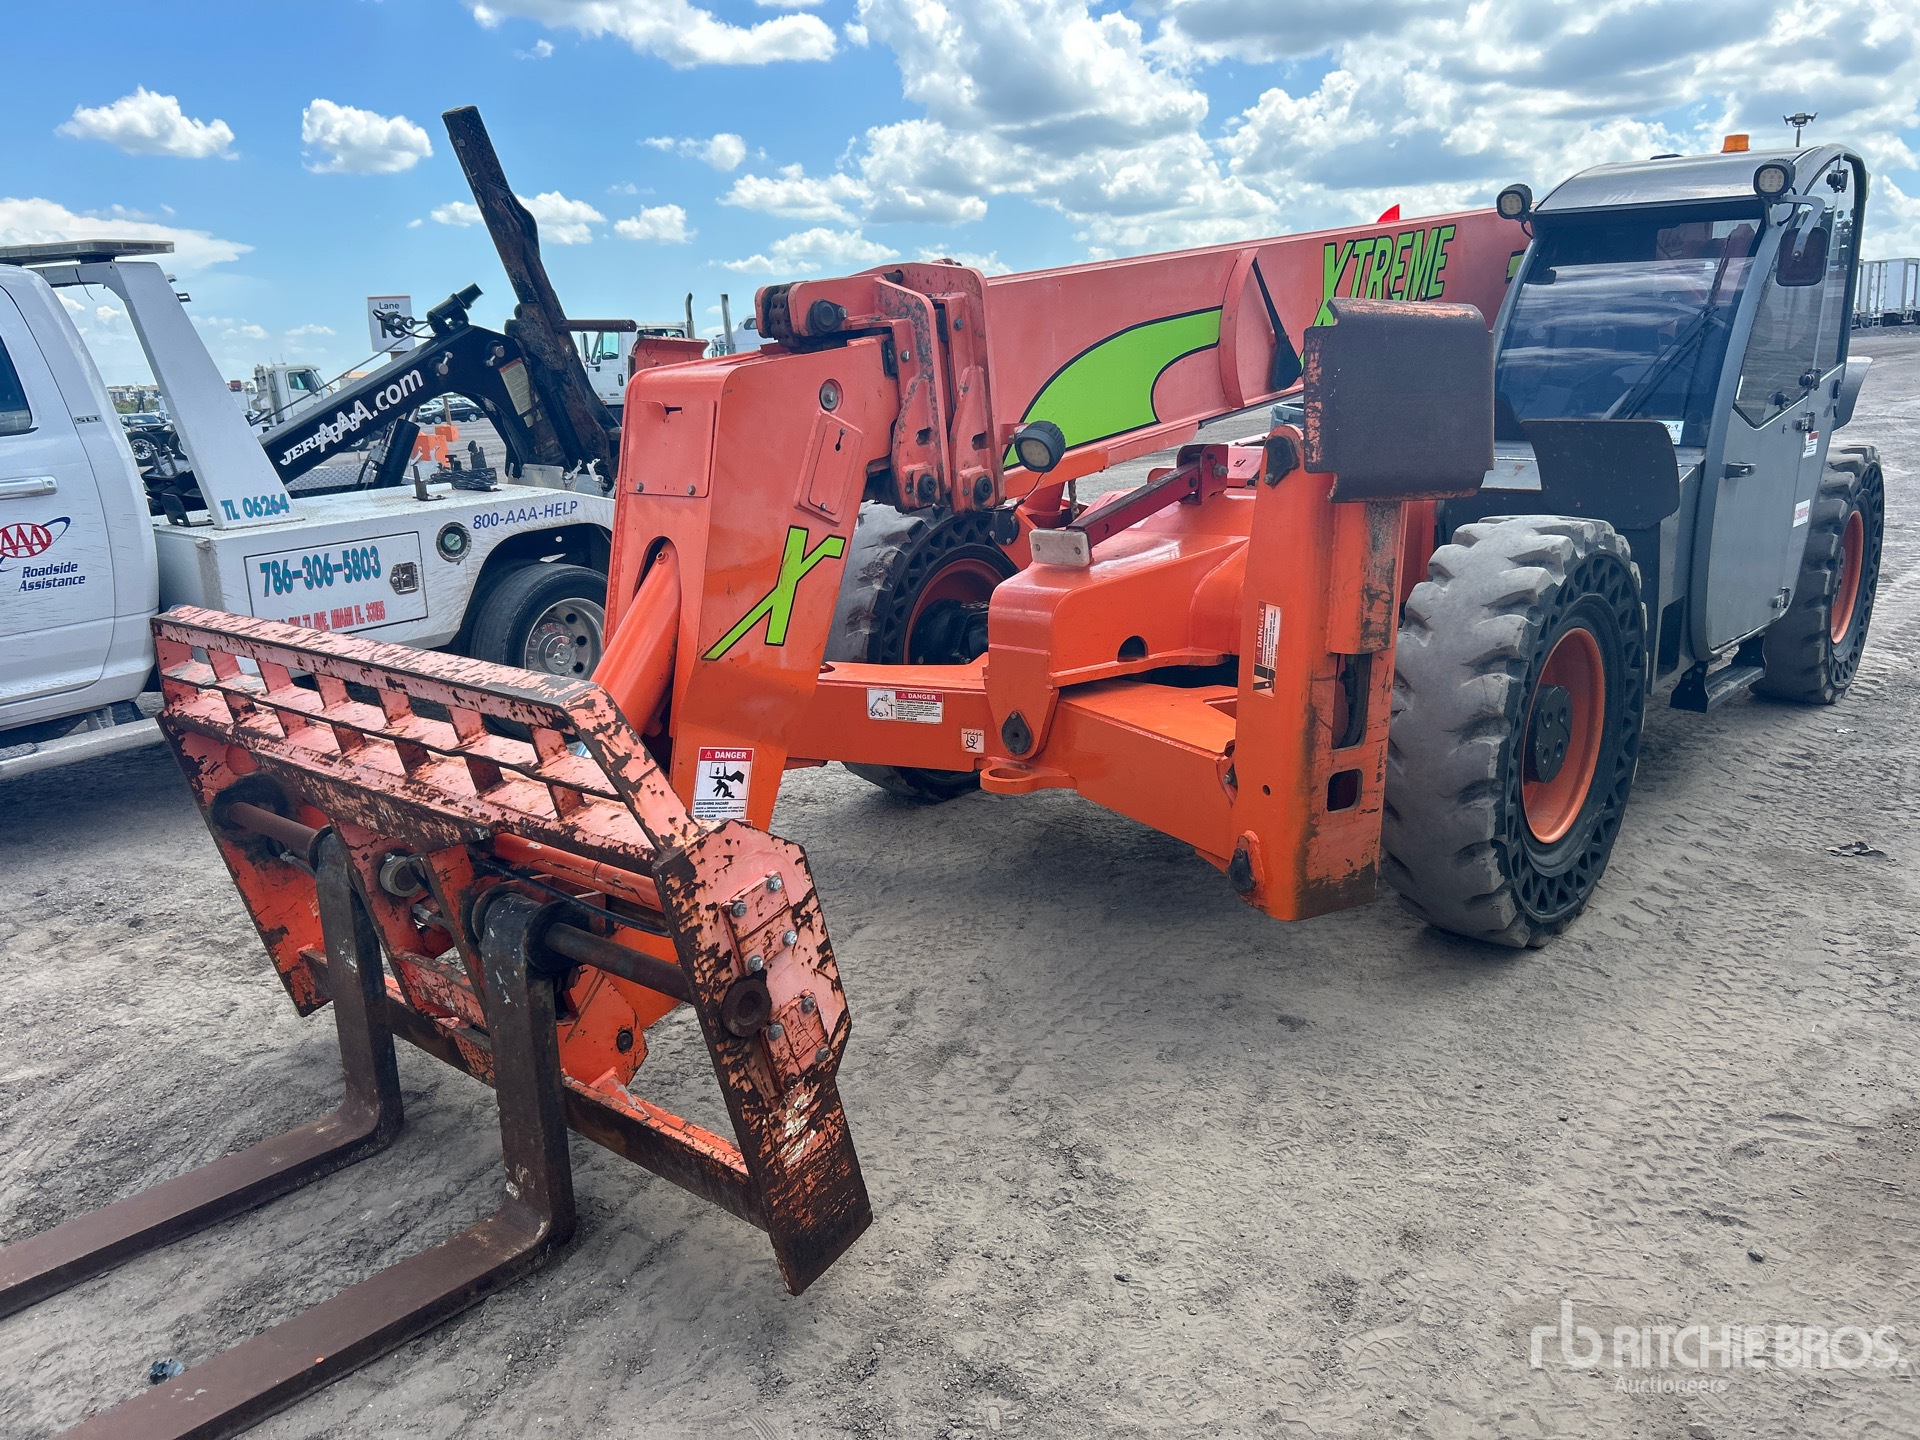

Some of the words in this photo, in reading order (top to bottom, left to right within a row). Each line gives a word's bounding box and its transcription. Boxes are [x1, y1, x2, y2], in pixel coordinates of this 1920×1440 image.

[1312, 224, 1456, 327] XTREME
[379, 302, 400, 310] Lane
[220, 499, 241, 521] TL
[242, 493, 290, 519] 06264
[473, 500, 578, 529] 800-AAA-HELP
[0, 523, 52, 558] AAA
[18, 575, 86, 593] Assistance
[22, 561, 78, 579] Roadside
[259, 545, 382, 598] 786-306-5803
[330, 606, 354, 630] MIAMI
[1257, 608, 1265, 648] DANGER
[715, 751, 746, 759] DANGER
